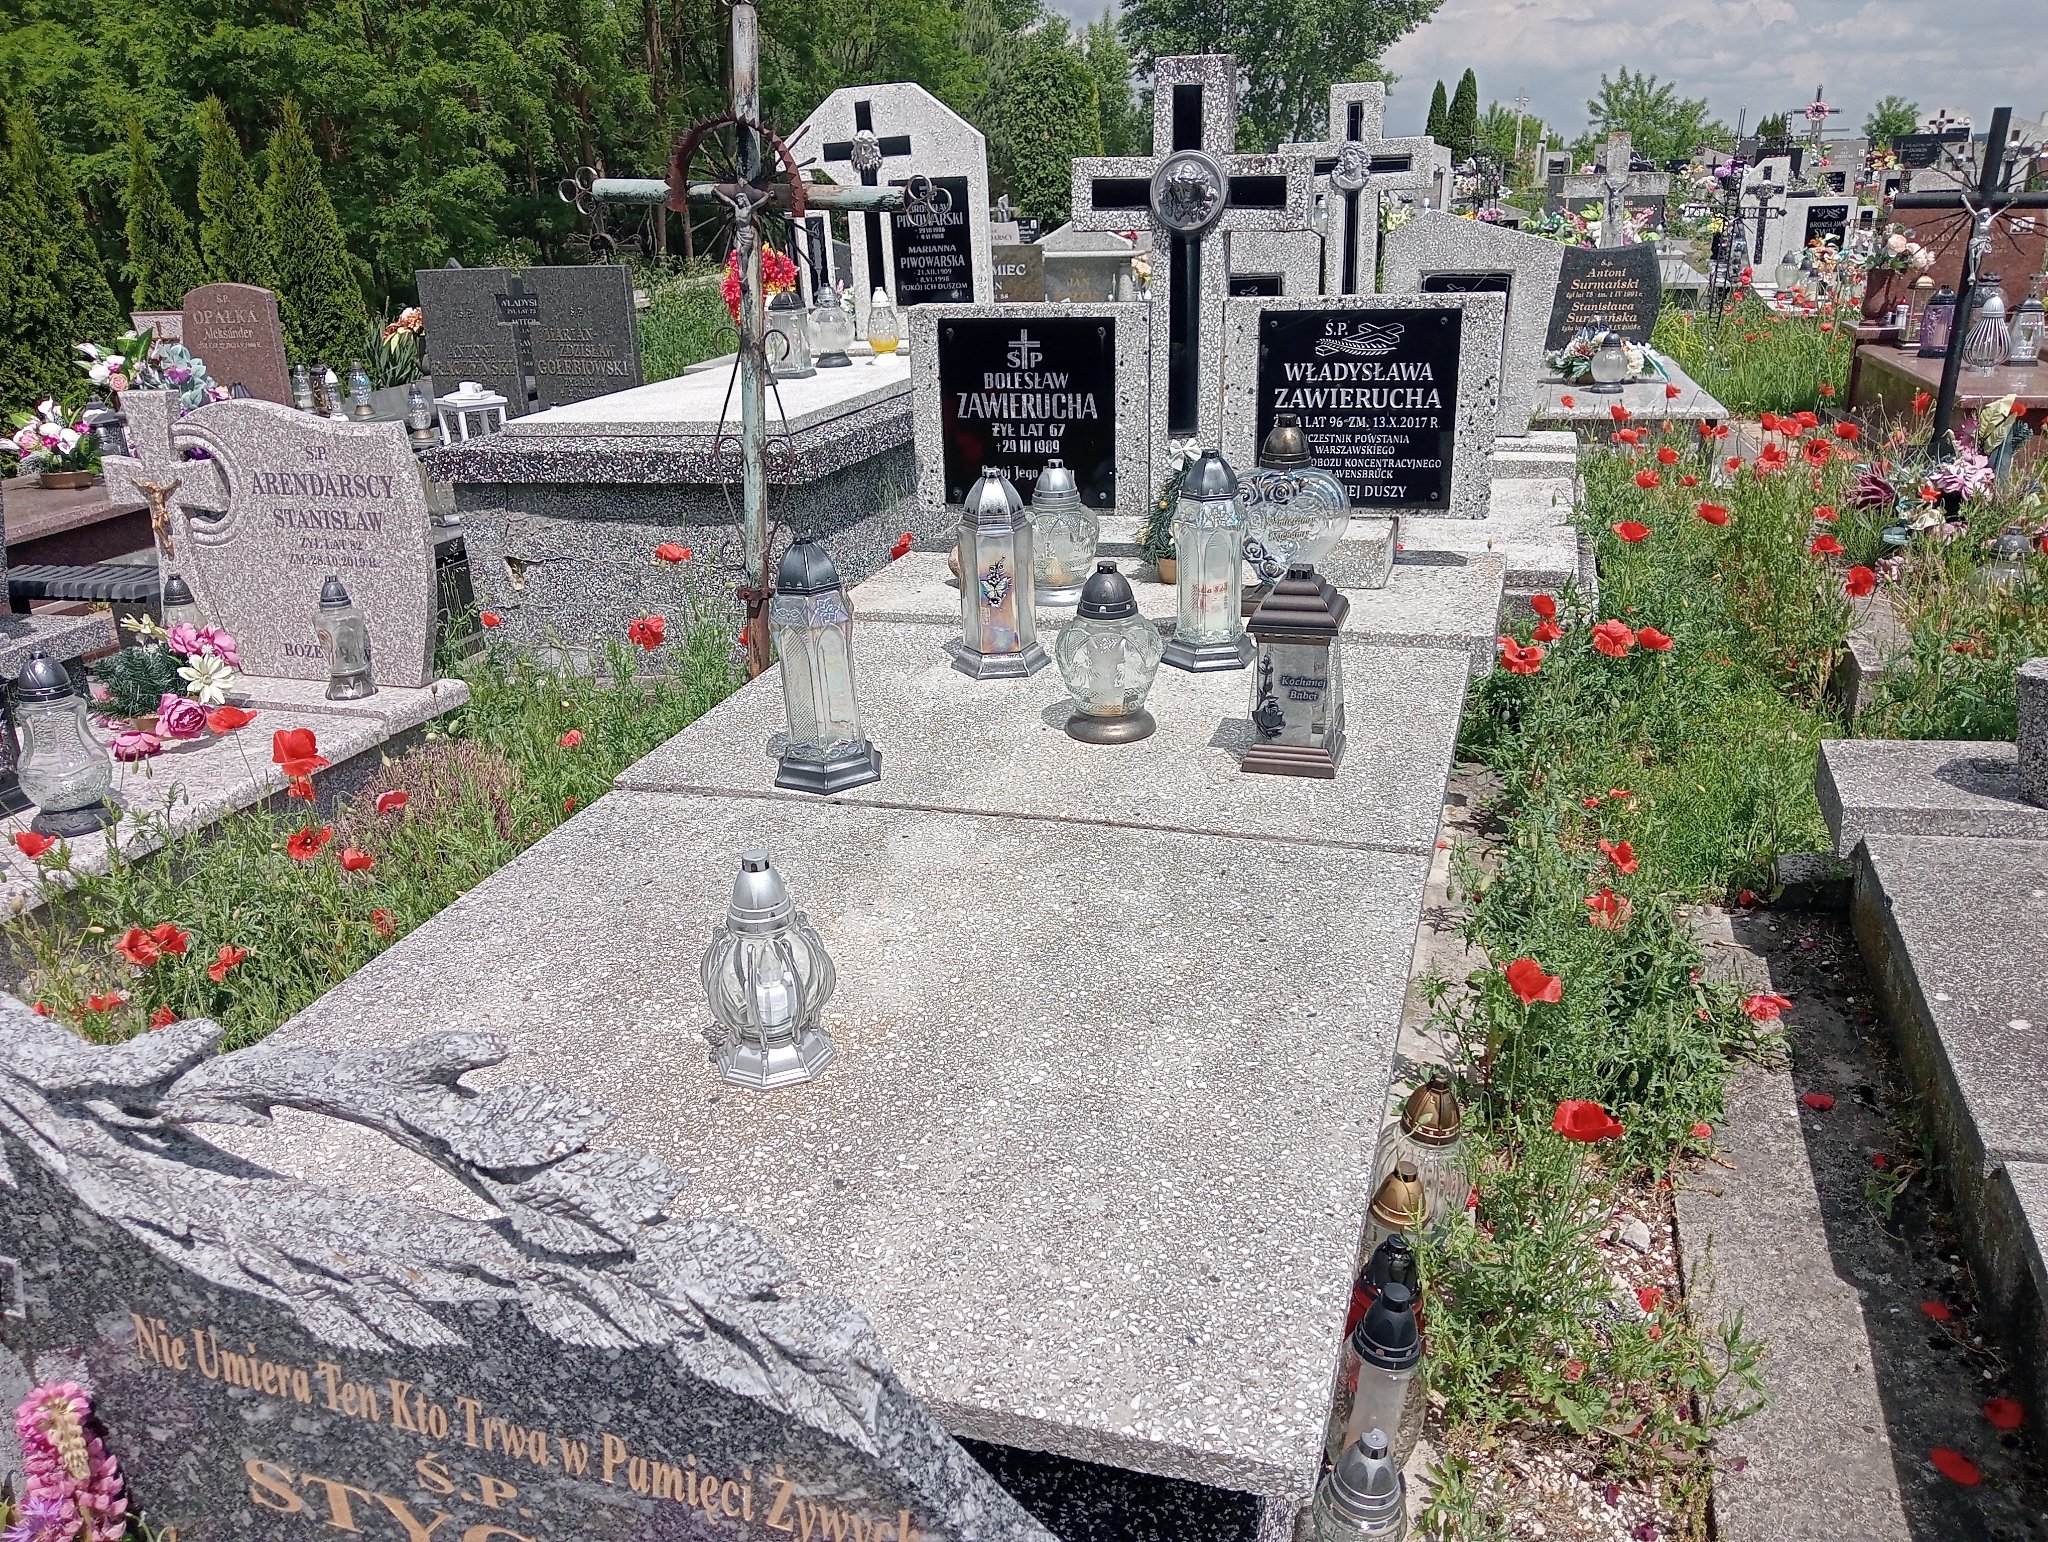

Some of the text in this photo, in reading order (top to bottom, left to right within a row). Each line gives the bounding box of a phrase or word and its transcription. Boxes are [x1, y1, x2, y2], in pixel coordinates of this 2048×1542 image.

[908, 244, 957, 254] MARIANNA
[900, 254, 966, 269] PIWOWARSKA
[1586, 268, 1627, 278] Antoni
[1570, 278, 1640, 290] Surmański
[1571, 301, 1635, 312] Stanisława
[192, 308, 260, 325] OPAŁKA
[1566, 312, 1638, 323] Surńska
[203, 326, 255, 341] Aleksander
[1325, 318, 1349, 336] Ś.P.
[1283, 362, 1434, 382] WŁADYSŁAWA
[983, 371, 1069, 390] BOLESŁAW
[1274, 387, 1442, 409] ZAWIERUCHA
[956, 392, 1099, 420] ZAWIERUCHA
[1273, 414, 1302, 428] ŻA
[1305, 416, 1327, 428] LAT
[1373, 416, 1427, 429] 13.X.2017
[1020, 423, 1045, 437] LAT
[1049, 423, 1066, 437] 67
[1034, 439, 1060, 453] 1989
[1305, 434, 1410, 444] CZESTNIK POWSTANIA
[1314, 445, 1395, 455] WARSZAWSKIEGO
[1344, 459, 1442, 470] KONCENTRACYJNEGO
[1014, 465, 1039, 481] Jego
[251, 470, 394, 499] ARENDARSCY
[1364, 485, 1407, 498] DUSZY
[273, 508, 383, 534] STANISŁAW
[323, 538, 346, 550] LAT
[349, 540, 363, 551] 82
[311, 553, 366, 568] 28.10.2019
[284, 640, 324, 659] BOŻE
[1280, 675, 1328, 689] Kochanej
[1289, 688, 1320, 701] Babci
[130, 1312, 188, 1371] Nie
[192, 1327, 313, 1404] Umiera
[317, 1360, 381, 1422] Ten
[388, 1376, 449, 1439] Kto
[456, 1395, 550, 1467] Trwa
[560, 1437, 589, 1476] w
[600, 1431, 754, 1525] Pamięci
[414, 1451, 534, 1518] Ś.P.
